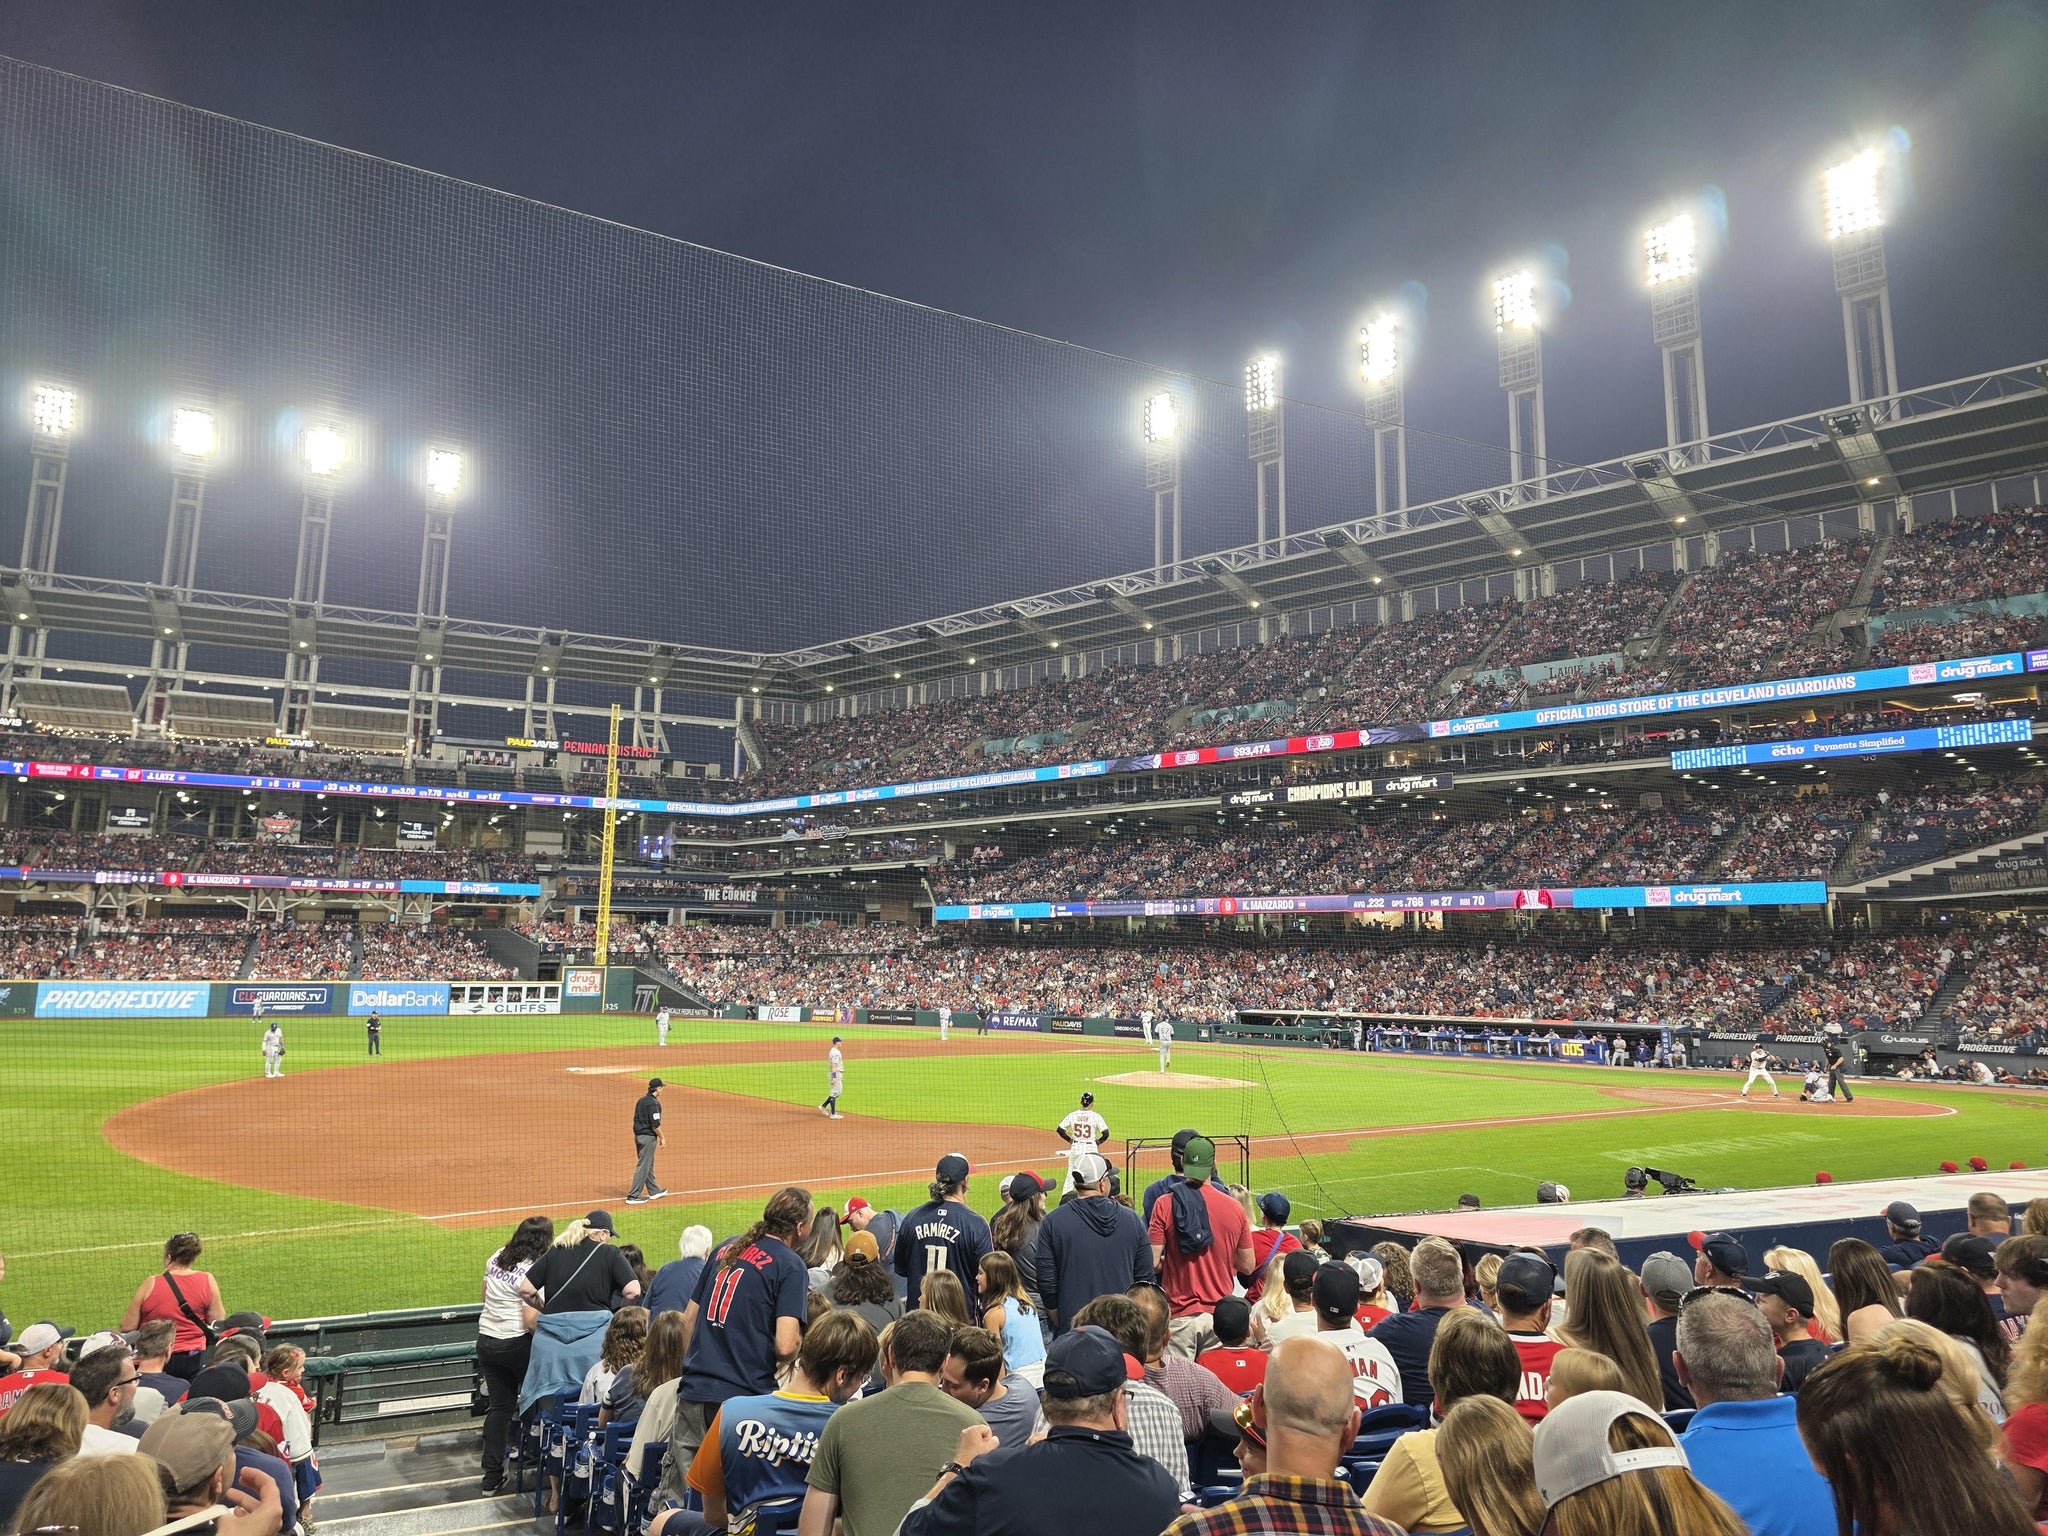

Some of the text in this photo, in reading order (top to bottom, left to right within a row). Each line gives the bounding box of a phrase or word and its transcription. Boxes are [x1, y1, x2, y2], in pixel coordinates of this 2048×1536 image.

[1941, 660, 2014, 678] drug mart
[1536, 675, 1856, 724] OFFICIAL DRUG STORE OF THE CLEVELAND GUARDIANS
[1453, 722, 1475, 733] drug
[1476, 719, 1499, 729] mart
[563, 741, 657, 759] PENNANT DISTRICT
[1771, 746, 1804, 757] echo
[1814, 736, 1905, 753] Payments Simplified
[155, 772, 175, 781] LATZ
[971, 774, 1002, 786] CLEVELAND
[1003, 770, 1036, 783] GUARDIANS
[1287, 780, 1373, 802] CHAMPIONS CLUB
[1386, 780, 1410, 793] drug
[1412, 777, 1438, 788] mart
[1230, 793, 1250, 806] drug
[1252, 792, 1274, 802] mart
[666, 803, 697, 812] OFFICIAL
[1994, 857, 2044, 870] drug mart
[197, 875, 240, 885] MANZARDO
[1950, 867, 2048, 892] CHAMPIONS CLUB
[462, 884, 479, 894] drug
[480, 885, 499, 893] mart
[704, 889, 757, 902] THE CORNER
[1366, 898, 1384, 908] .232
[1441, 896, 1452, 906] 27
[1472, 895, 1485, 906] 70
[1674, 890, 1742, 905] drug mart
[1251, 900, 1294, 910] MANZARDO
[570, 970, 596, 985] drug
[571, 985, 600, 993] mart
[40, 990, 199, 1009] PROGRESSIVE
[494, 1003, 547, 1013] CLIFFS
[605, 1003, 619, 1011] 325
[768, 1007, 789, 1021] ROSE
[1003, 1015, 1038, 1028] RE/MAX
[1708, 1032, 1759, 1041] PROGRESSIVE
[1894, 1036, 1928, 1044] LEXUS
[1957, 1043, 2019, 1054] PROGRESSIVE
[1074, 1123, 1091, 1139] 53
[915, 1219, 961, 1244] RAMÍREZ
[924, 1244, 948, 1272] 11
[489, 1267, 518, 1286] MOON
[707, 1266, 745, 1324] 11
